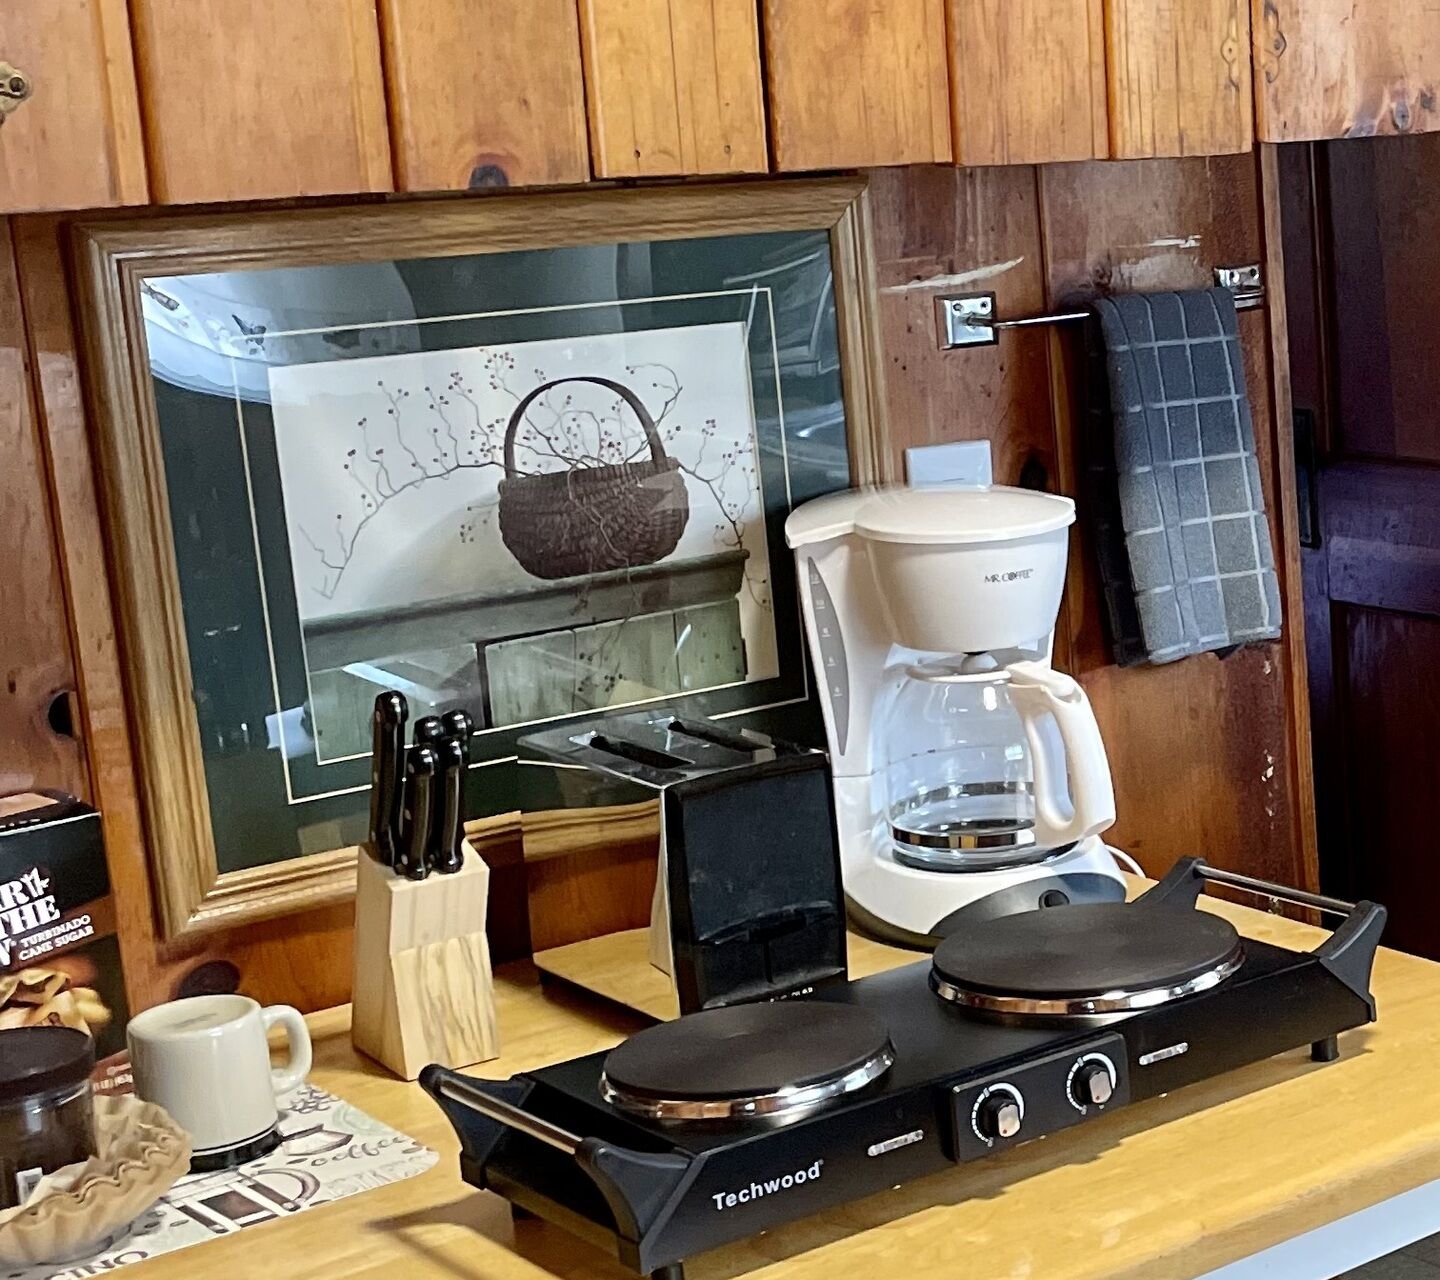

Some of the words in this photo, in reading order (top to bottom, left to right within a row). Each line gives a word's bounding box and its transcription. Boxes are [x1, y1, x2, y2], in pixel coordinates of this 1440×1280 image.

[19, 940, 54, 961] CANE
[54, 925, 95, 948] SUGAR
[20, 914, 91, 948] TURBINADO
[712, 1160, 822, 1210] Techwood
